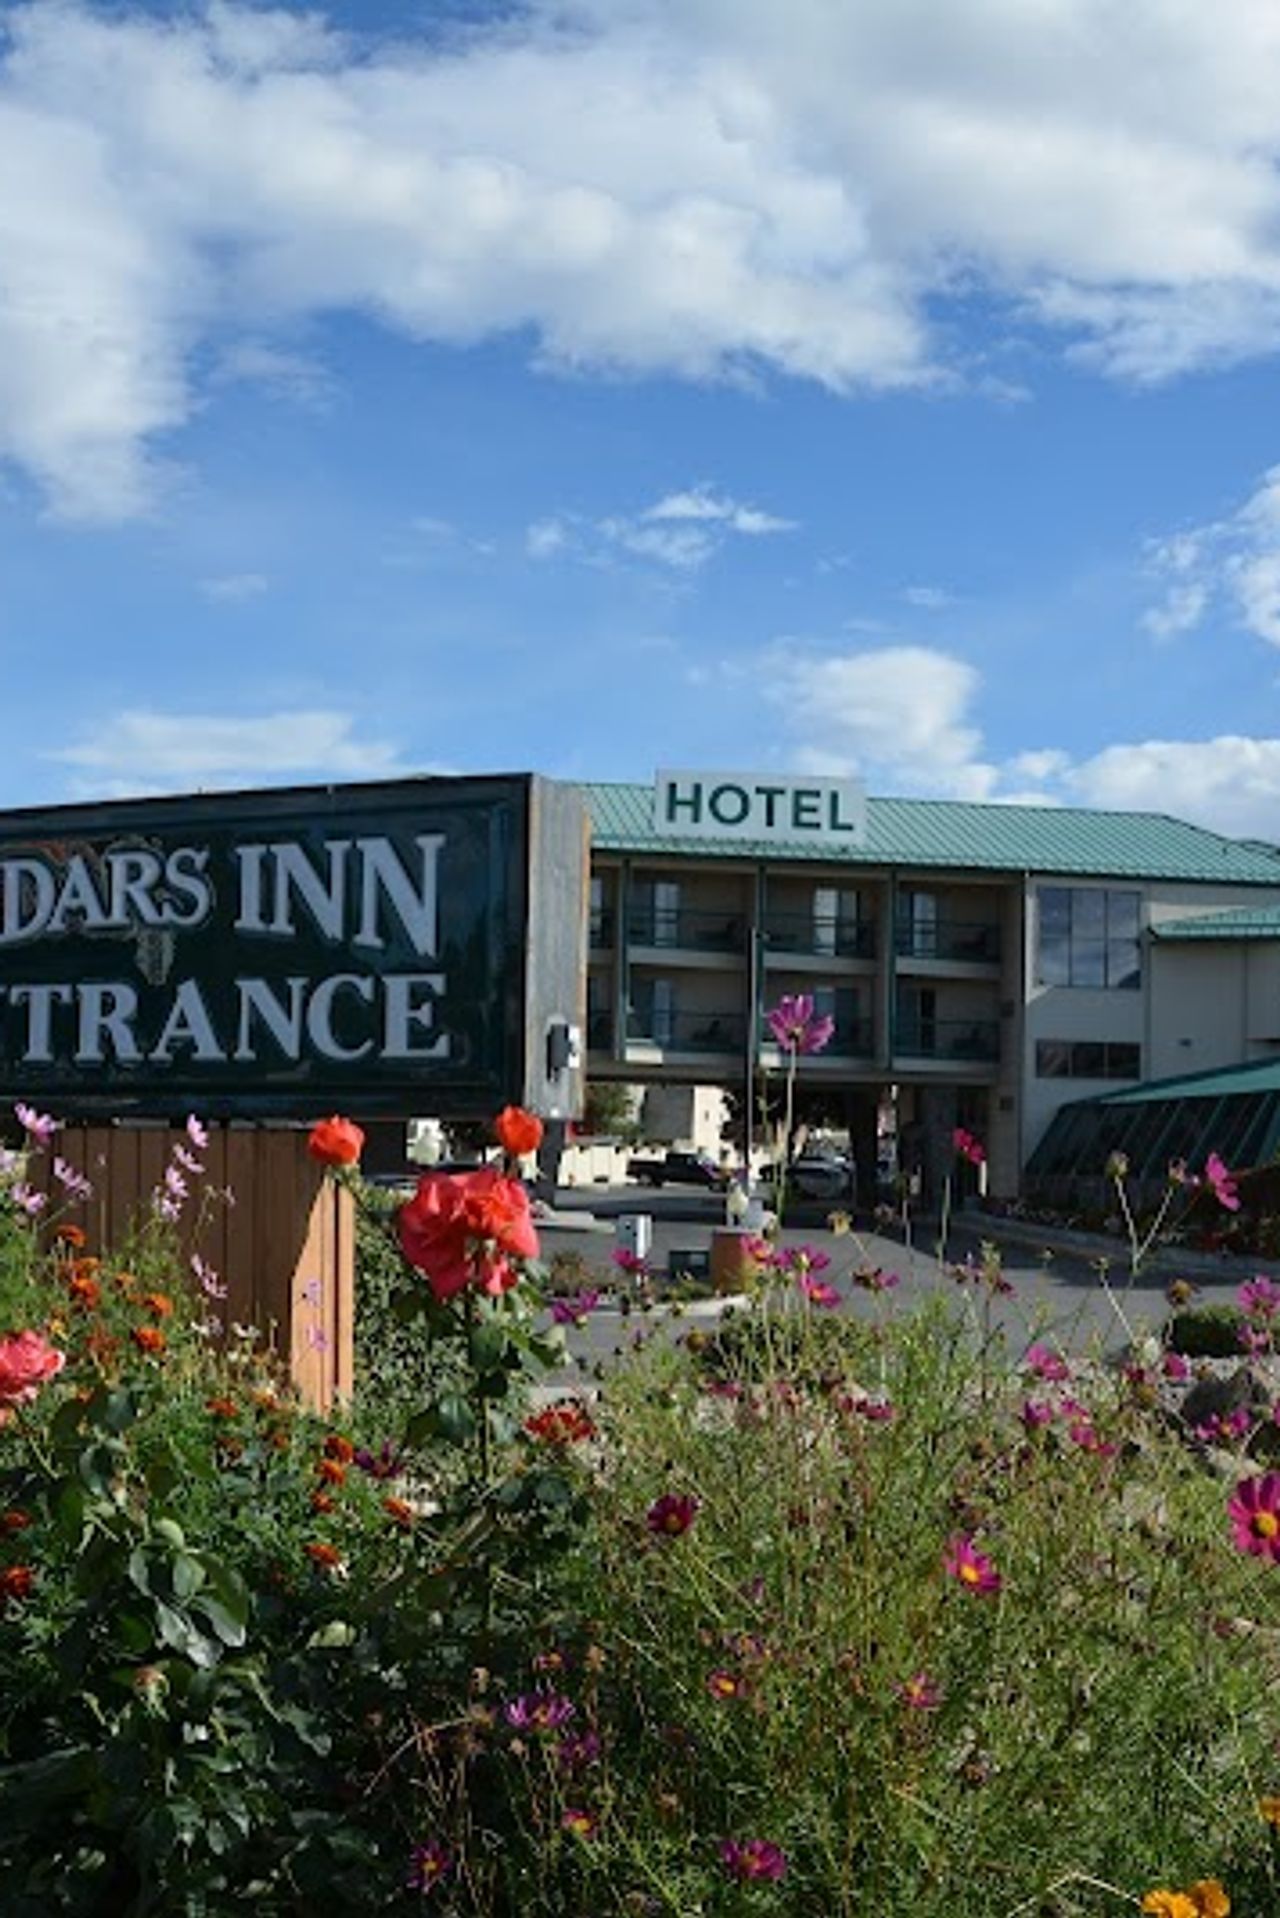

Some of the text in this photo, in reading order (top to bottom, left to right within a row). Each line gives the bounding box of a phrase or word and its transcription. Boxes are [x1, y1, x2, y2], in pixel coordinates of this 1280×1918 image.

[666, 782, 854, 830] HOTEL
[0, 834, 446, 957] DARS INN
[0, 974, 451, 1062] TRANCE
